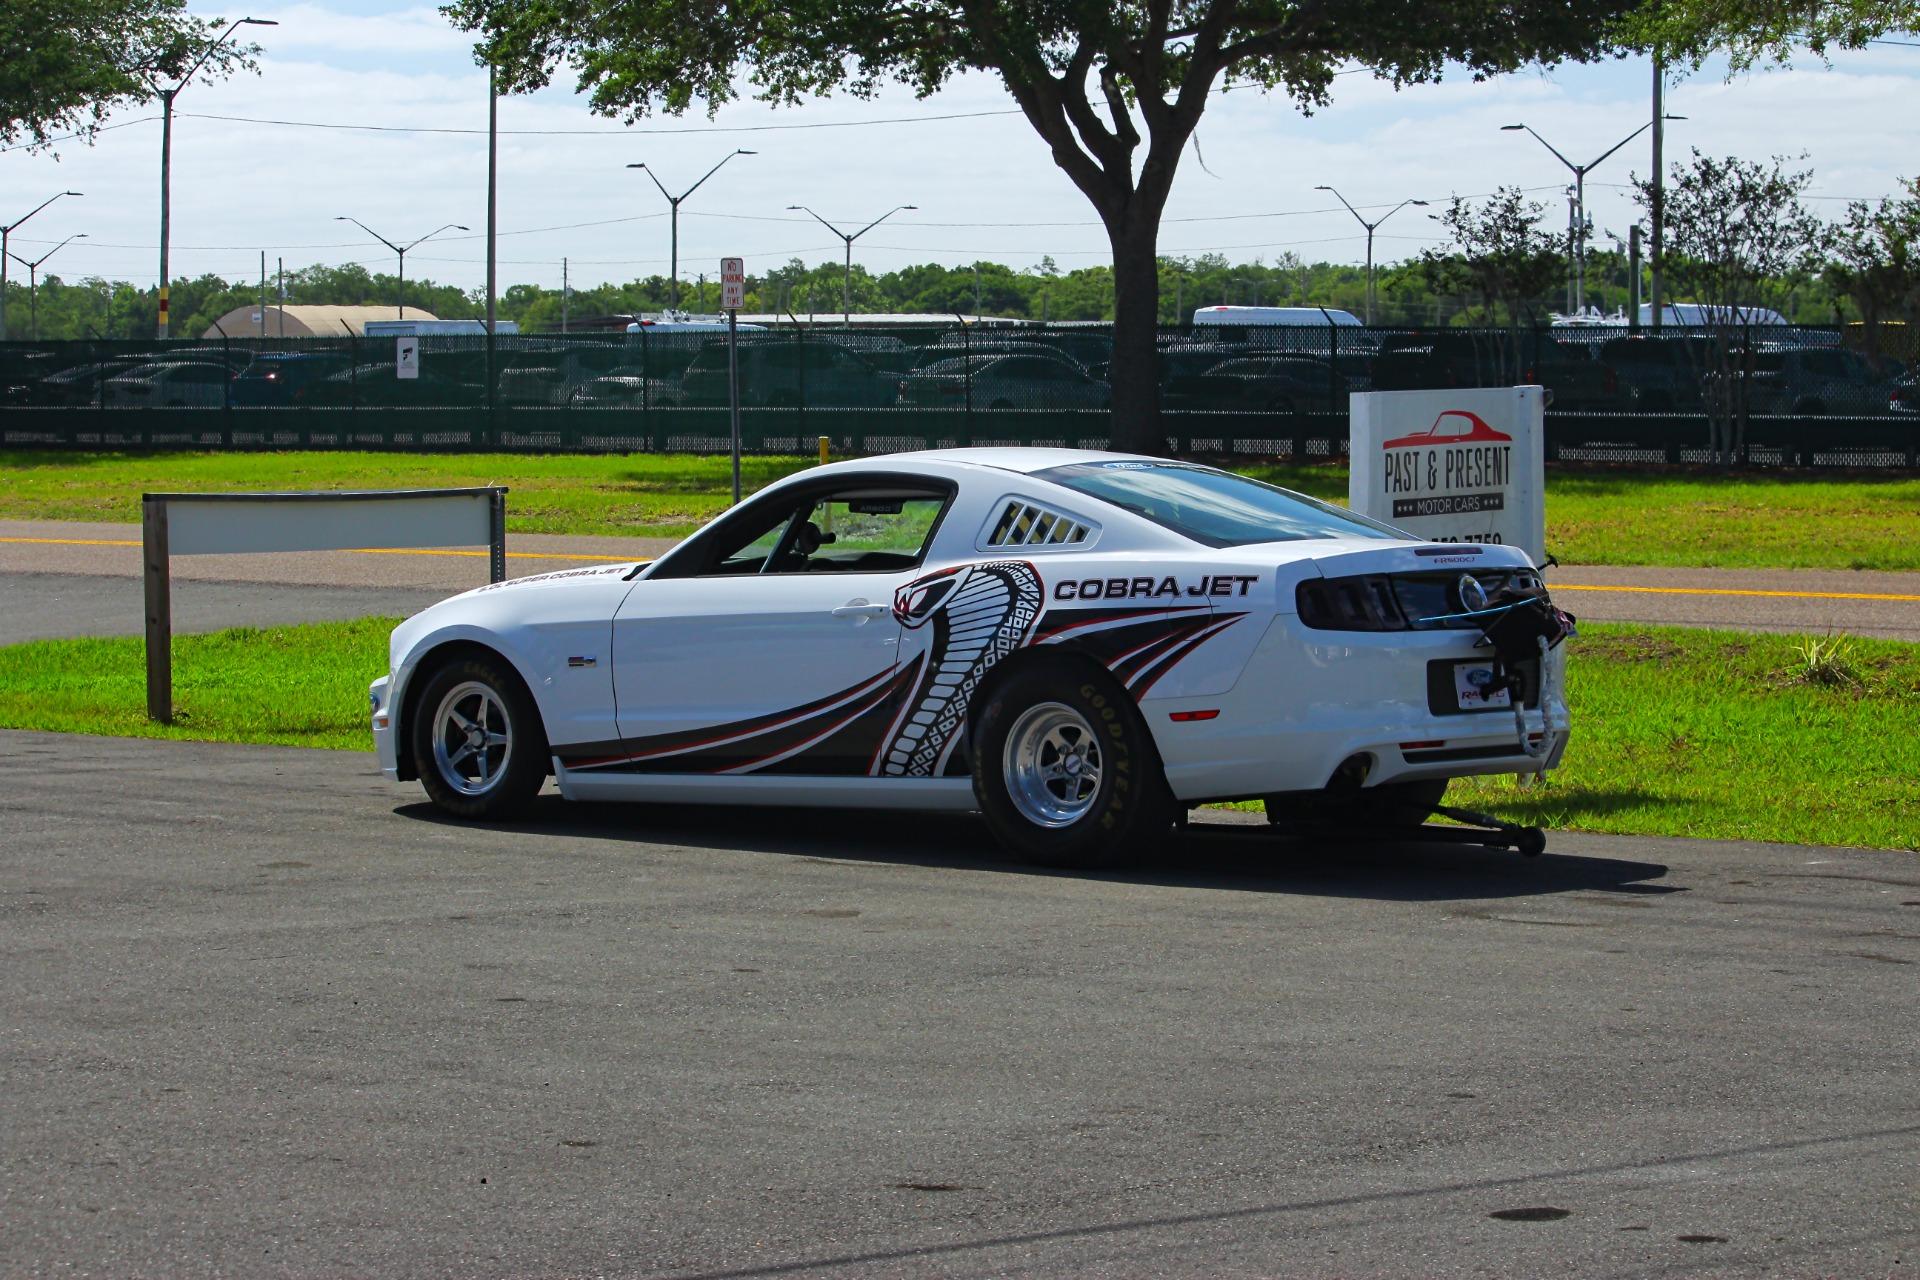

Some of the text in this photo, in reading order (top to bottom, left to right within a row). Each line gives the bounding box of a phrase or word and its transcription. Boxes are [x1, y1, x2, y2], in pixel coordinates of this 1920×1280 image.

[727, 261, 737, 272] NO
[726, 296, 740, 305] TIME
[1384, 446, 1511, 493] PAST & PRESENT
[1417, 496, 1480, 515] MOTOR CARS
[505, 574, 550, 586] SUPER
[550, 569, 598, 580] COBRA
[599, 567, 628, 575] JET
[1053, 574, 1260, 601] COBRA JET
